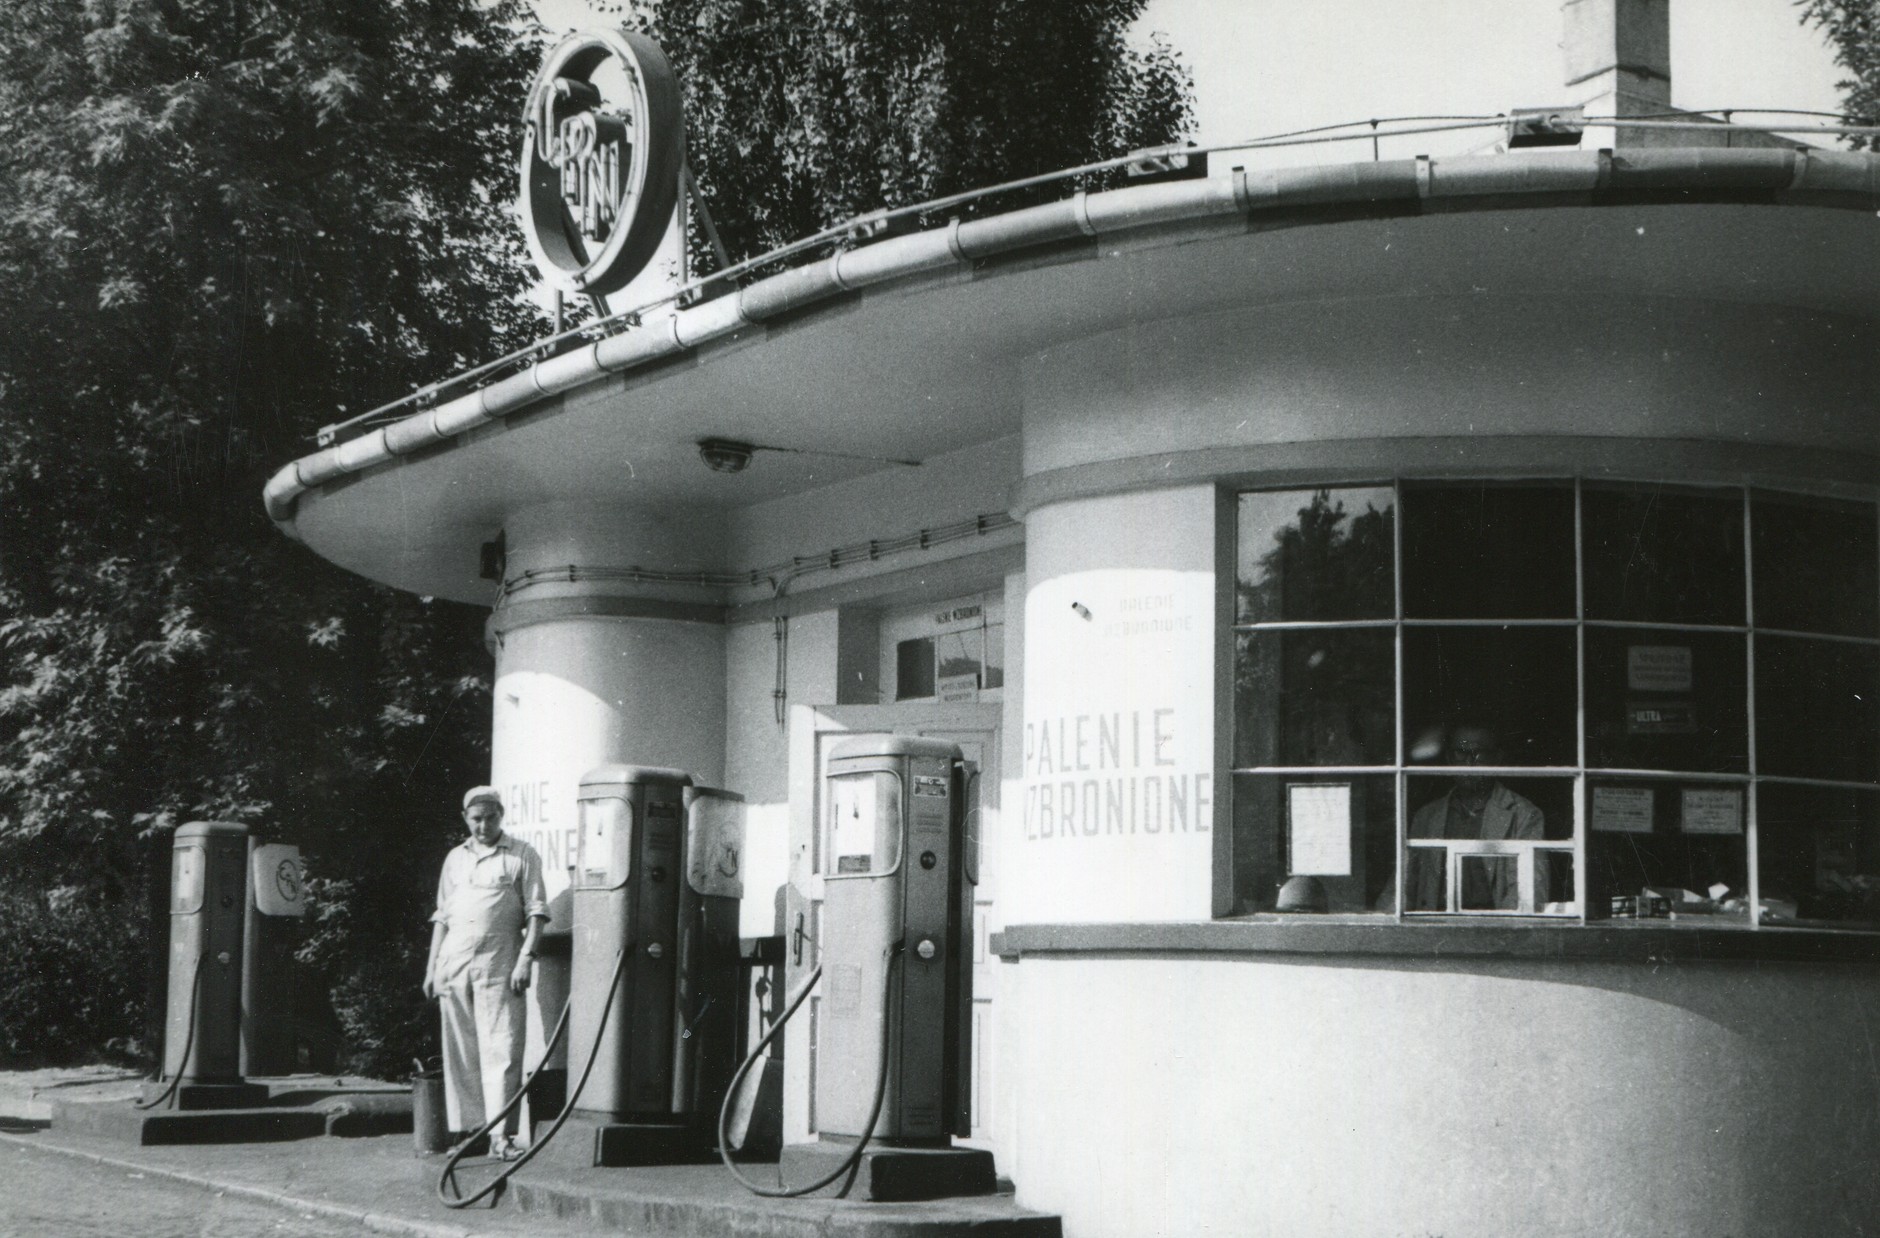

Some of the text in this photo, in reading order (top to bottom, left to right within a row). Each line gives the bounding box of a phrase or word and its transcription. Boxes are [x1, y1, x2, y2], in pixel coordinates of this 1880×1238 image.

[1026, 707, 1176, 777] PALENIE
[1636, 710, 1662, 722] ULTRA
[505, 781, 549, 826] LENIE
[1023, 772, 1211, 841] ZBRONIONE
